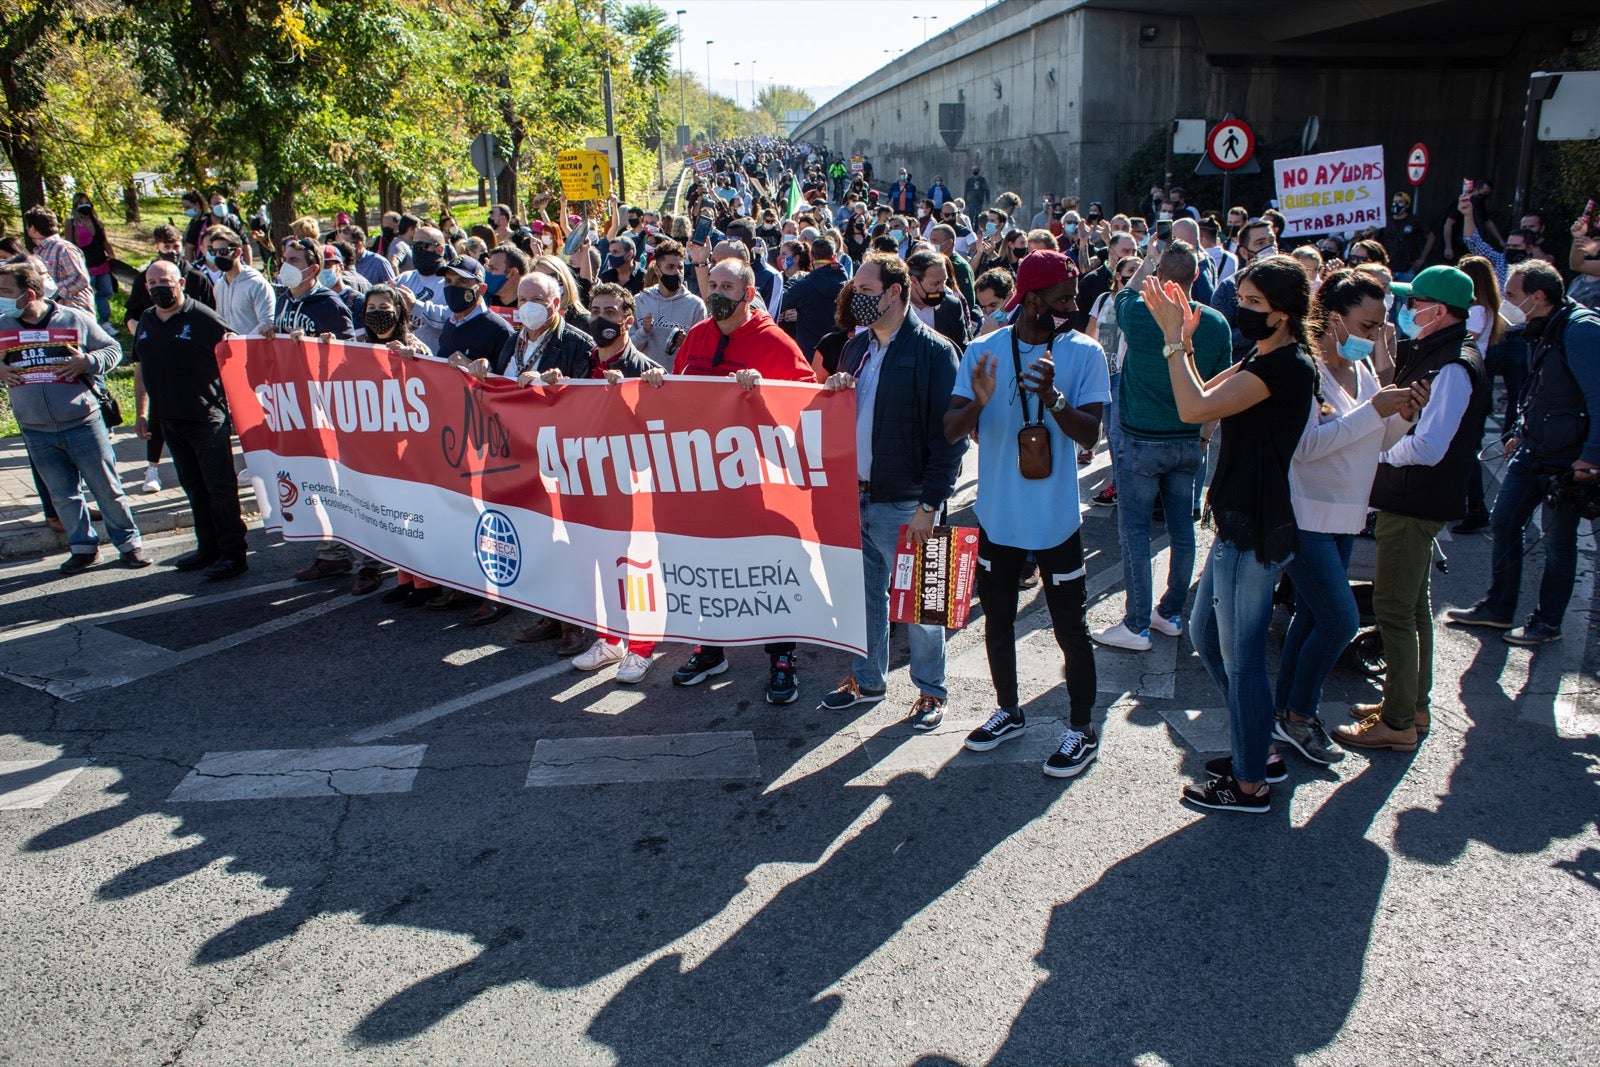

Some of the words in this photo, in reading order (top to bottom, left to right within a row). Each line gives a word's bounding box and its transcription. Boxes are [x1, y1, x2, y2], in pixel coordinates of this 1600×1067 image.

[1283, 167, 1308, 188] NO
[1315, 161, 1383, 186] AYUDAS
[1289, 207, 1380, 232] TRABAJAR!
[37, 357, 45, 365] LA
[255, 382, 305, 433] SIN
[307, 377, 430, 434] AYUDAS
[537, 409, 829, 496] Arruinan!
[304, 497, 319, 507] de
[379, 519, 388, 531] de
[388, 522, 425, 540] Granada
[371, 502, 380, 514] de
[380, 504, 425, 524] Empresas
[480, 537, 517, 556] HORECA
[925, 538, 939, 569] 5.000
[939, 536, 948, 579] ABANDONADAS
[662, 560, 801, 590] HOSTELERÍA
[925, 570, 938, 584] DE
[955, 553, 969, 600] MANIFESTACIÓN
[666, 592, 693, 615] DE
[699, 590, 792, 618] ESPAÑA
[936, 580, 946, 612] EMPRESAS
